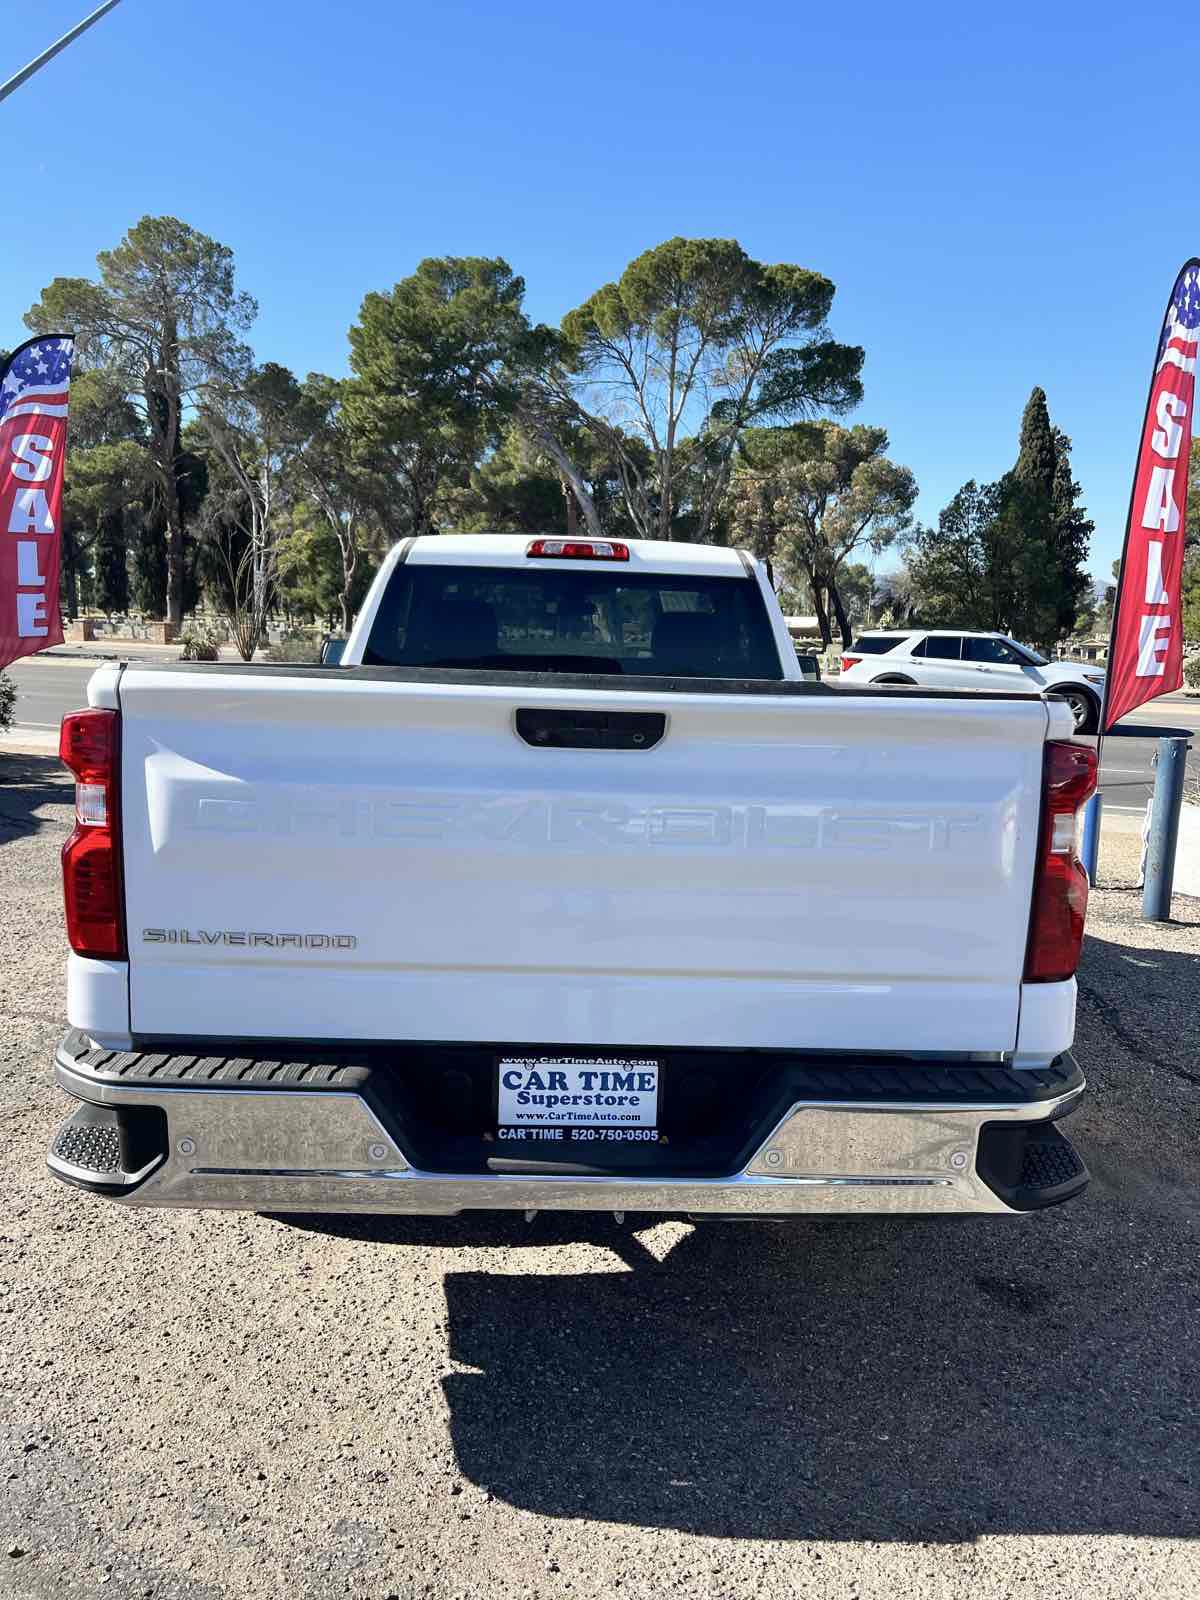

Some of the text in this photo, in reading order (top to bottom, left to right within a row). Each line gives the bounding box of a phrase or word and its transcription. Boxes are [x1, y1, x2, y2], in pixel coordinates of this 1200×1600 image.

[7, 434, 55, 638] SALE
[1136, 390, 1186, 677] SALE
[142, 928, 358, 949] SILVERADO
[502, 1057, 658, 1067] www.CarTimeAuto.com
[502, 1070, 656, 1092] CAR TIME
[516, 1091, 641, 1108] Superstore
[516, 1111, 641, 1121] www.CarTimeAuto.com
[499, 1128, 659, 1141] CAR TIME 520-750-0505
